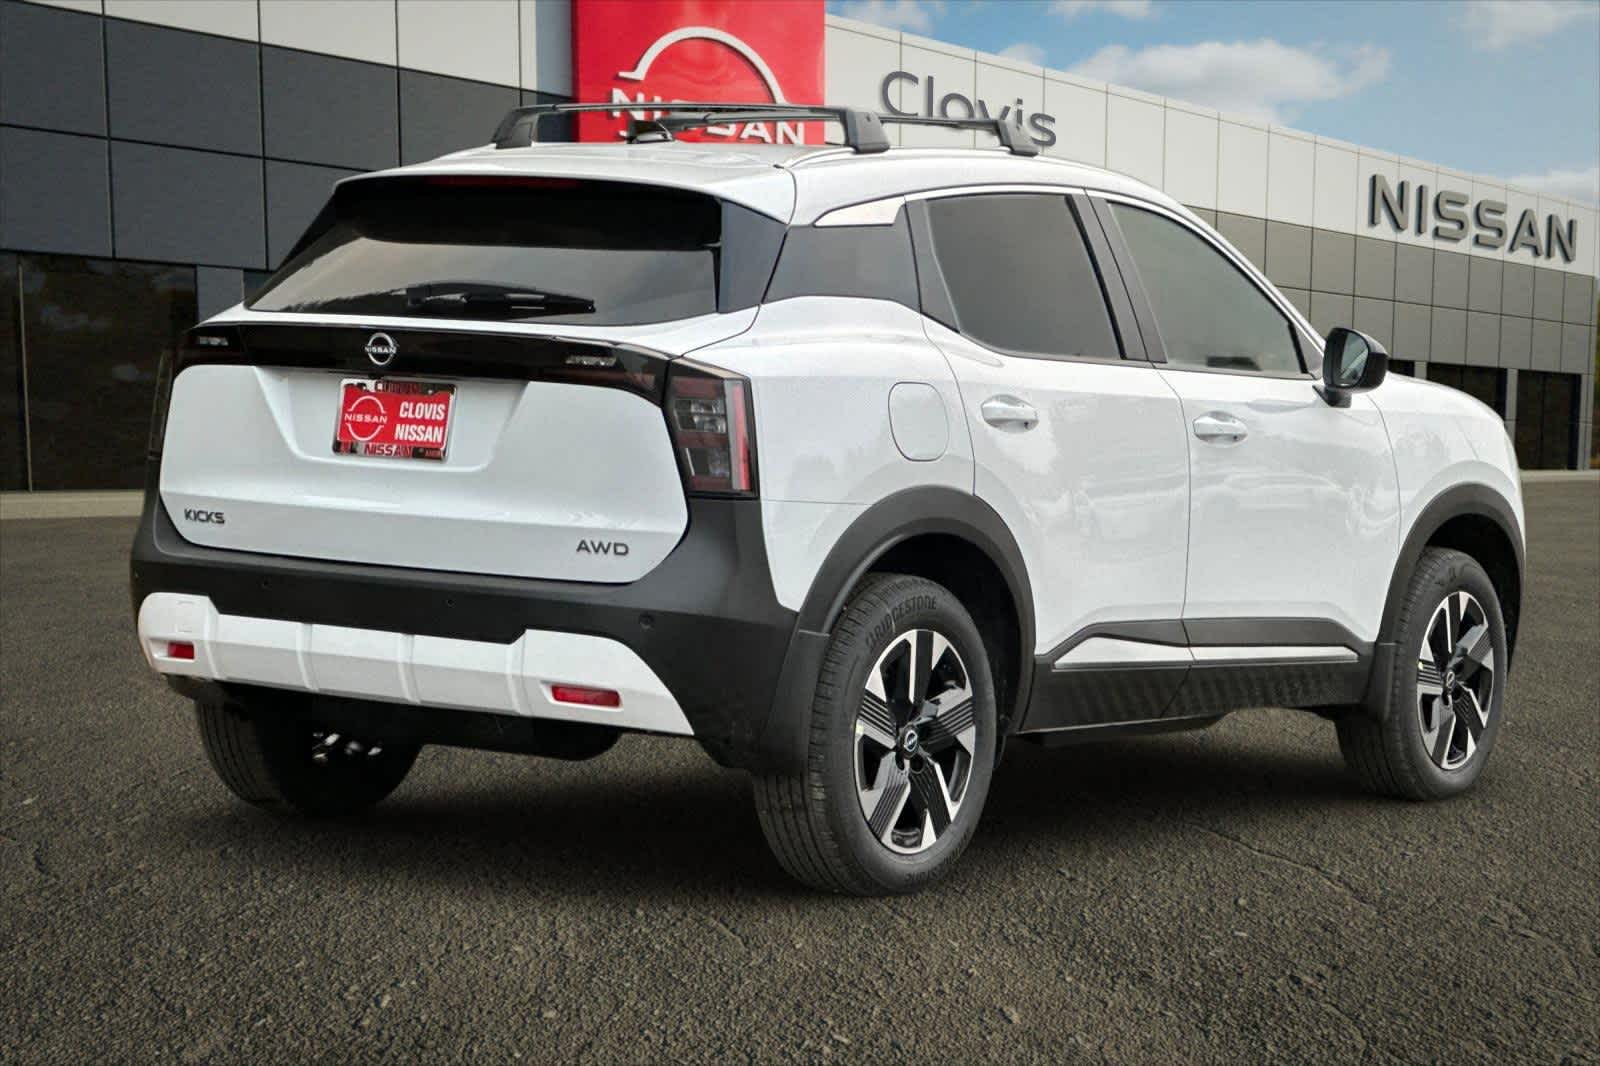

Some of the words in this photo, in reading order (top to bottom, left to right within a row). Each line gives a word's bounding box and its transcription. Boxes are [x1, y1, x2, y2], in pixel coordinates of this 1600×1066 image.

[611, 87, 806, 145] NIAN
[881, 70, 1057, 147] Clovis
[1368, 173, 1578, 263] NISSAN
[364, 344, 397, 354] NISSAN
[344, 413, 388, 424] NISSAN
[399, 401, 446, 421] CLOVIS
[394, 423, 444, 443] NISSAN
[364, 443, 413, 457] NISSAN
[184, 508, 225, 524] KICKS
[576, 539, 629, 556] AWD
